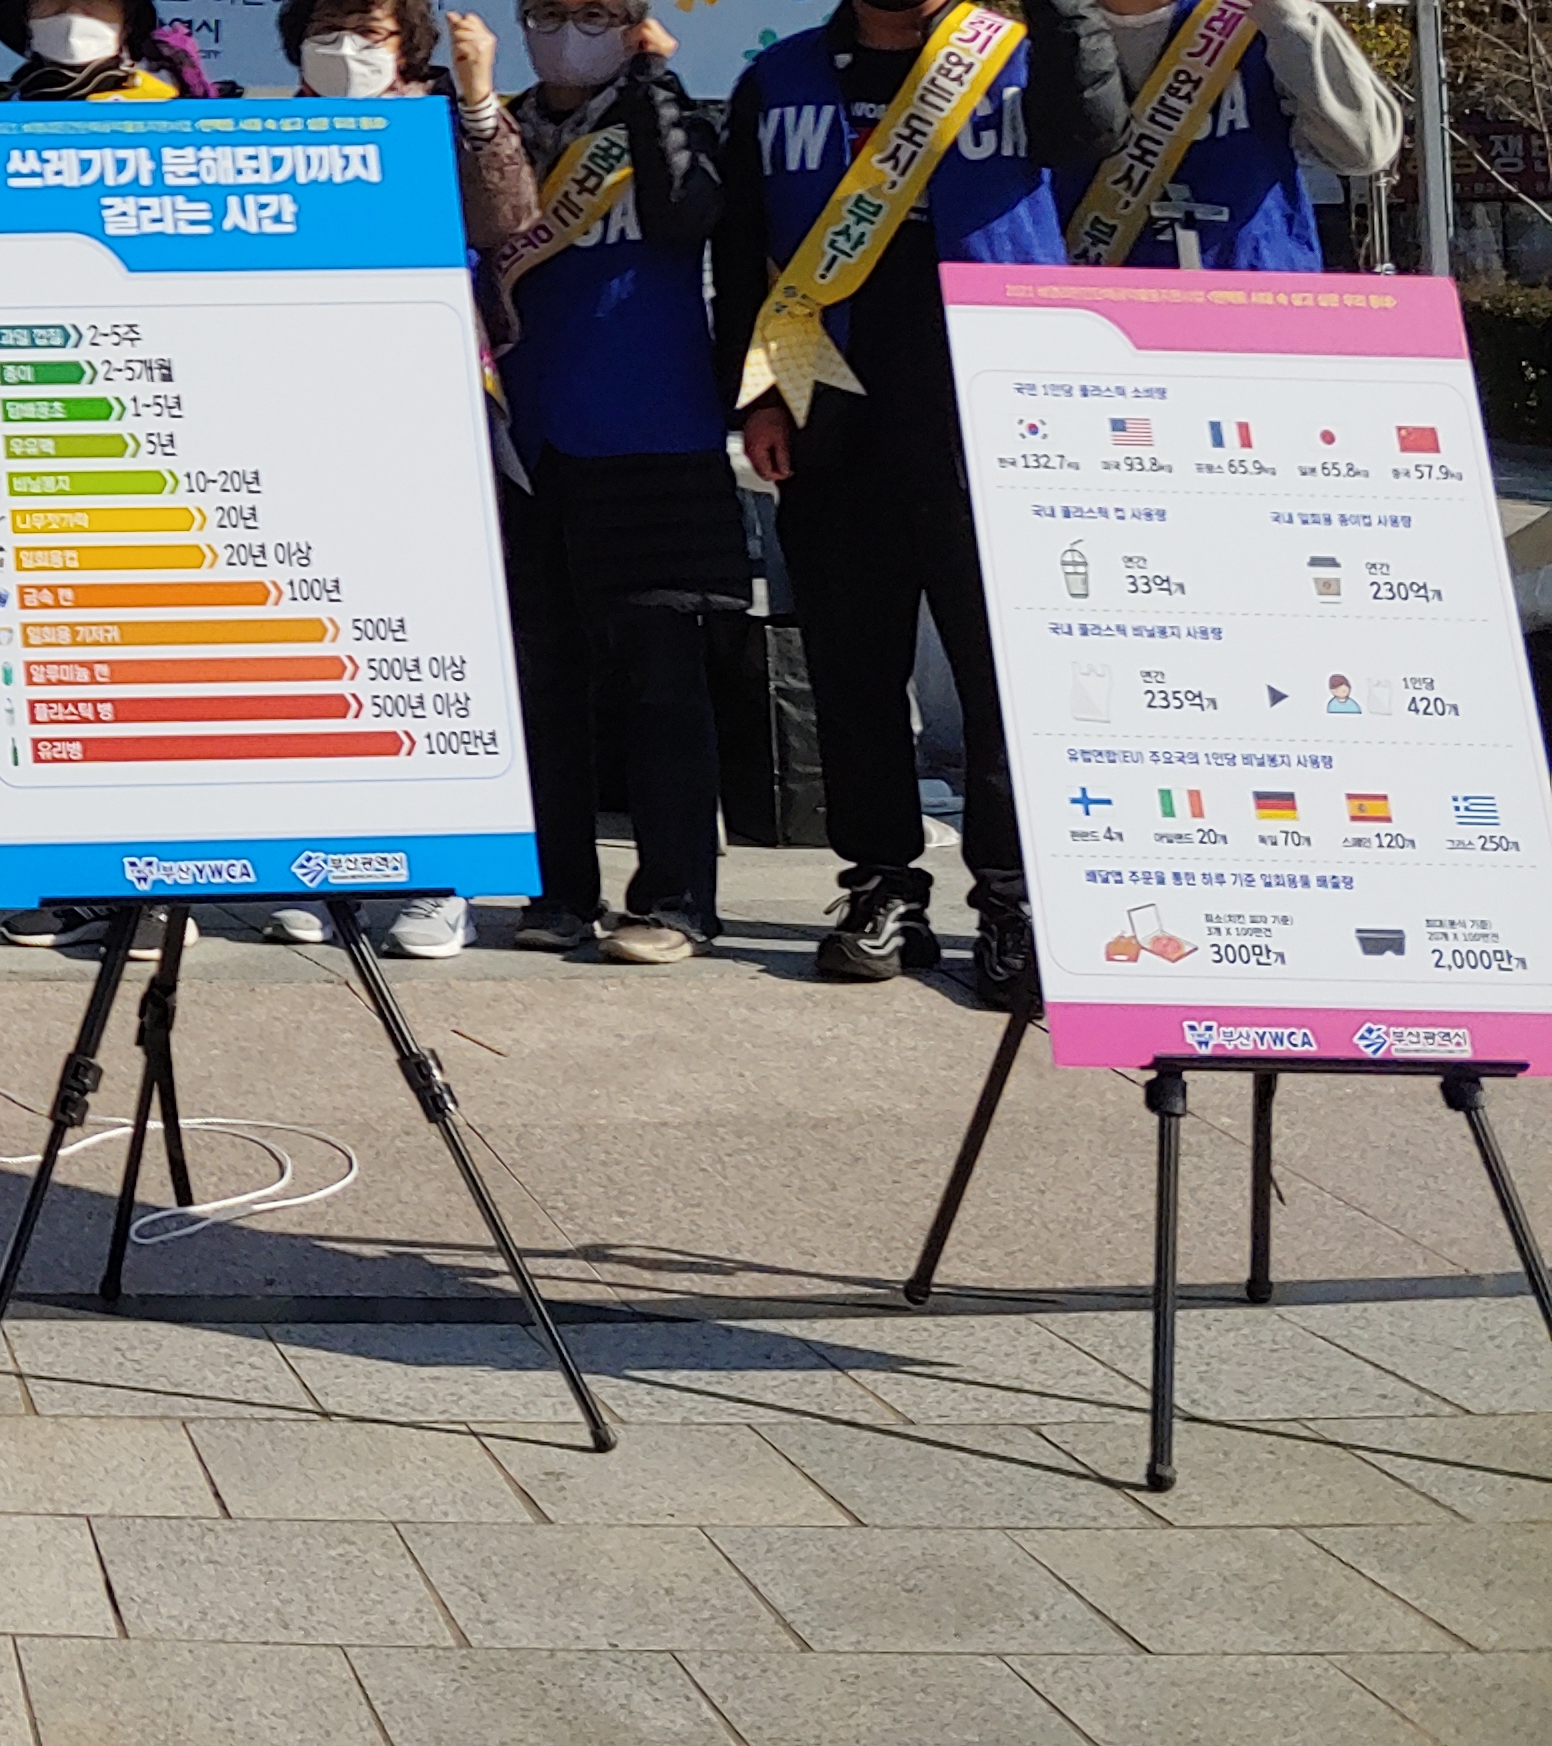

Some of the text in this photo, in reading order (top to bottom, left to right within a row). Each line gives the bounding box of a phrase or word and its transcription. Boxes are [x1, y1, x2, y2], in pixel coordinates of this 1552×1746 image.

[919, 50, 975, 113] 없는
[1148, 68, 1203, 132] 없는
[6, 144, 382, 187] 쓰레기가 분해되기까지
[101, 194, 298, 236] 걸리는 시간
[146, 432, 177, 457] 5년
[215, 505, 259, 531] 20년
[224, 541, 313, 568] 20년 이상
[287, 578, 343, 603] 100년
[1125, 574, 1187, 596] 33억개
[1369, 581, 1444, 603] 230억개
[351, 616, 408, 643] 500년
[366, 655, 467, 682] 500년 이상
[370, 691, 472, 719] 500년 이상
[1143, 689, 1218, 712] 235억개
[424, 730, 500, 756] 100만년
[195, 863, 252, 880] YWCA
[1209, 943, 1287, 967] 300만개
[1431, 948, 1529, 972] 2,000만개
[1221, 1029, 1315, 1049] 부산 YWCA
[1392, 1029, 1468, 1047] 부산광역시
